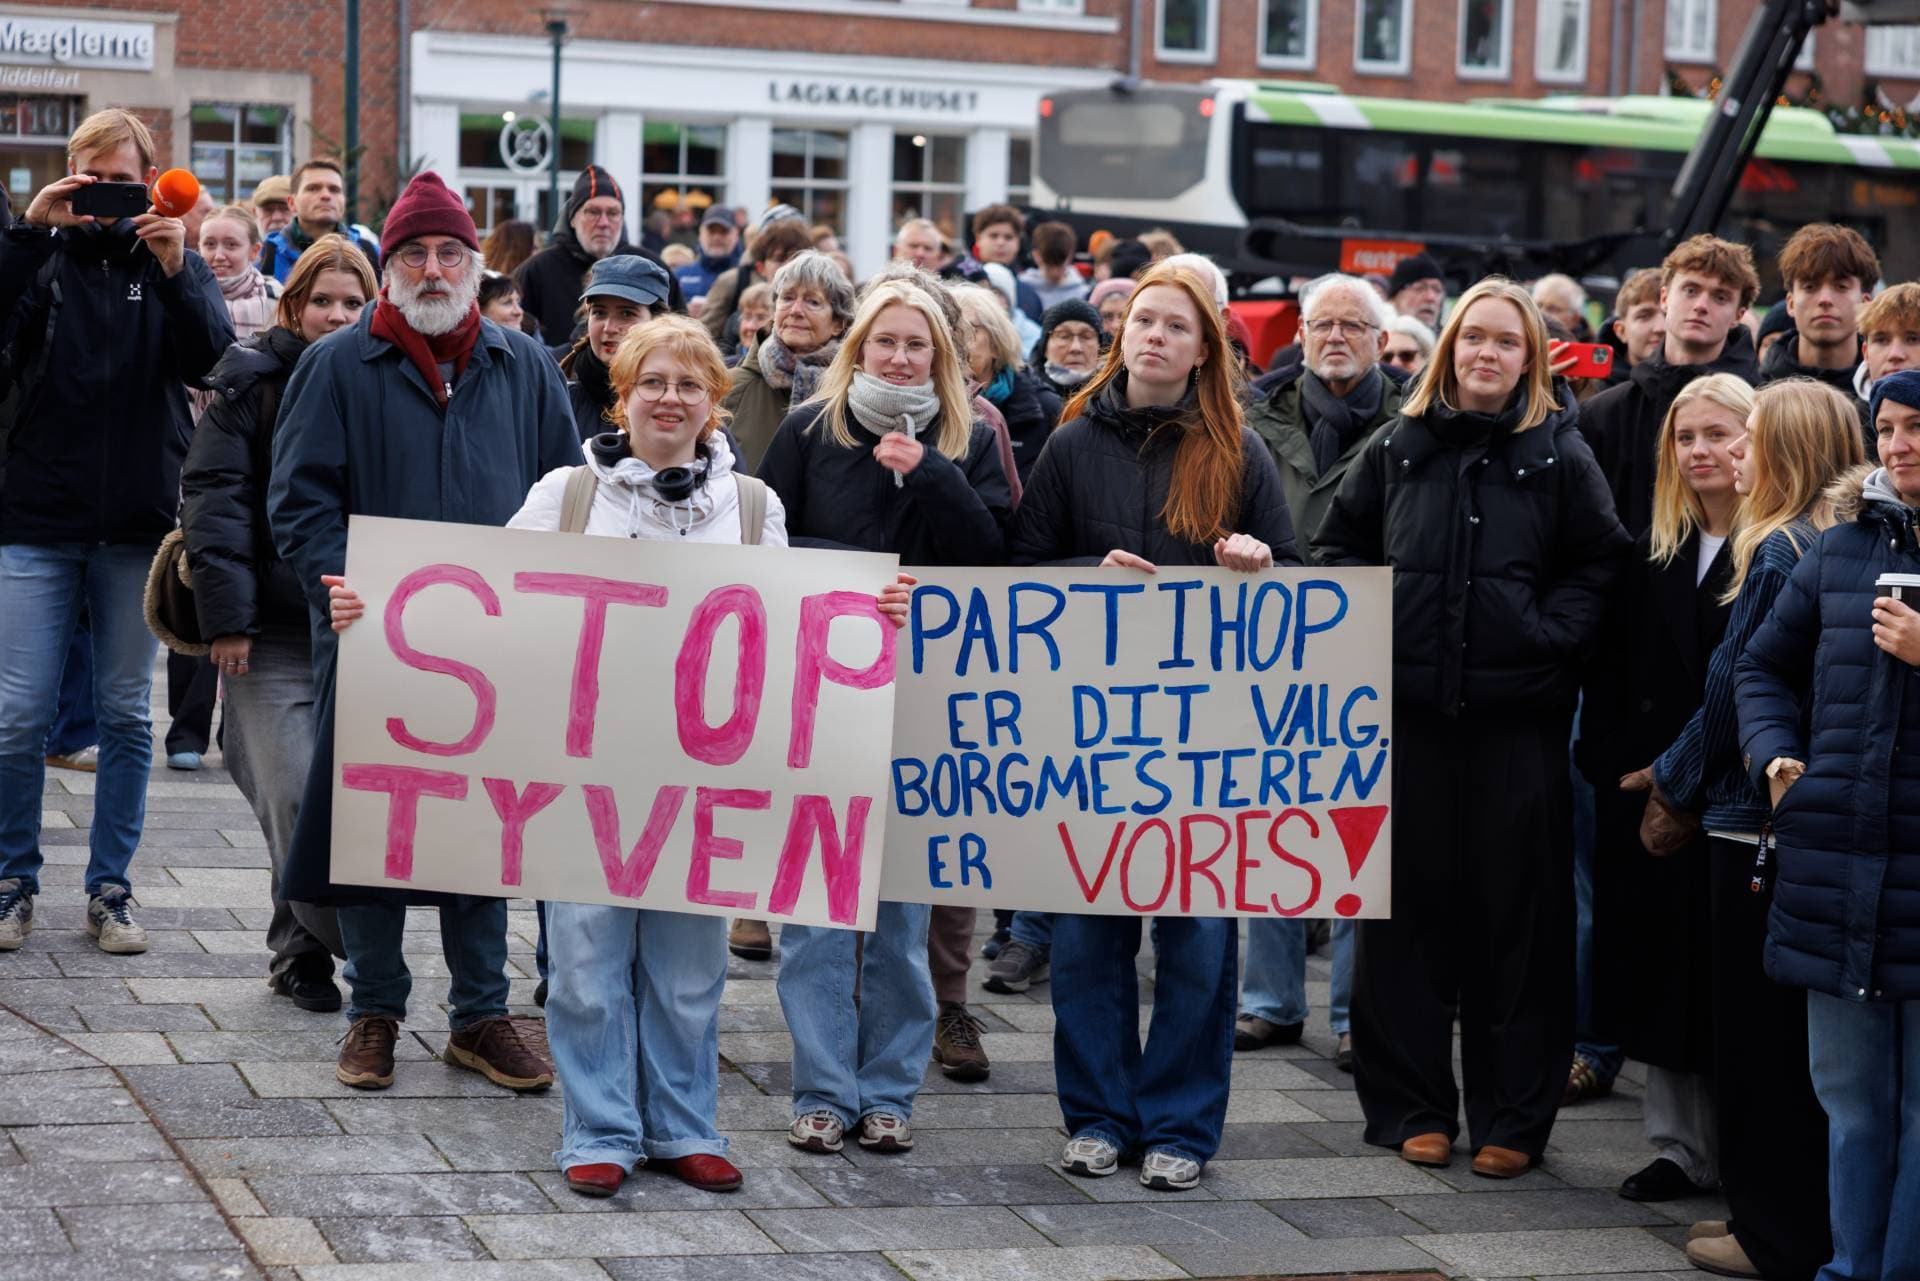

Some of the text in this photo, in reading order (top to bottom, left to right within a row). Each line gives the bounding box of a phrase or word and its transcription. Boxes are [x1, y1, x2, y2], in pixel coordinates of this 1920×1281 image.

[0, 66, 80, 89] iddelfart
[769, 81, 979, 112] LAGKAGEHUSET
[385, 564, 897, 768] STOP
[911, 580, 1348, 676] PARTIHOP
[948, 683, 1389, 750] ER DIT VALG.
[892, 748, 1387, 817] BORGMESTEREN
[342, 763, 872, 925] TYVEN
[929, 805, 1389, 918] ER VORES!
